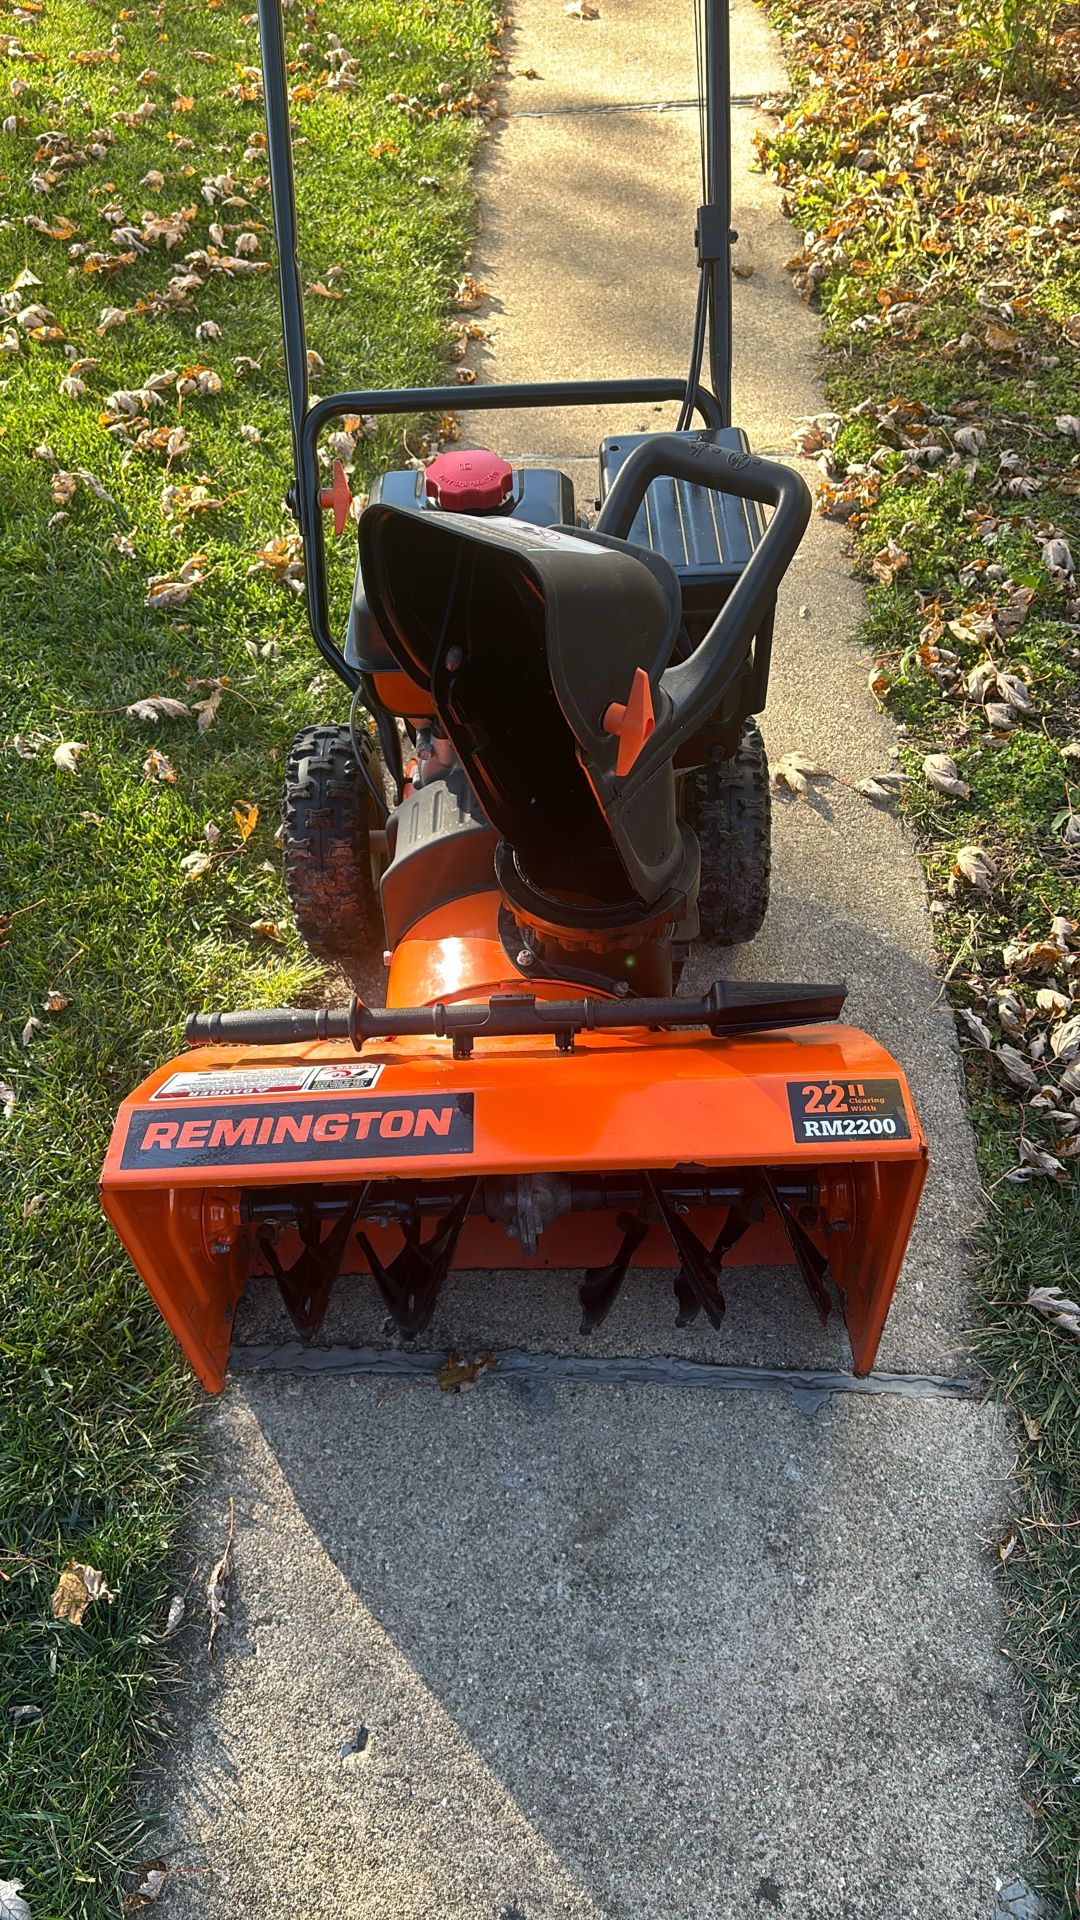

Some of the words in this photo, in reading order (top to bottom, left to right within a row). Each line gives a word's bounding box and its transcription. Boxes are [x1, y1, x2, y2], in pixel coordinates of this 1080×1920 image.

[188, 1087, 253, 1097] DANGER
[140, 1108, 455, 1151] REMINGTON
[803, 1118, 896, 1137] RM2200
